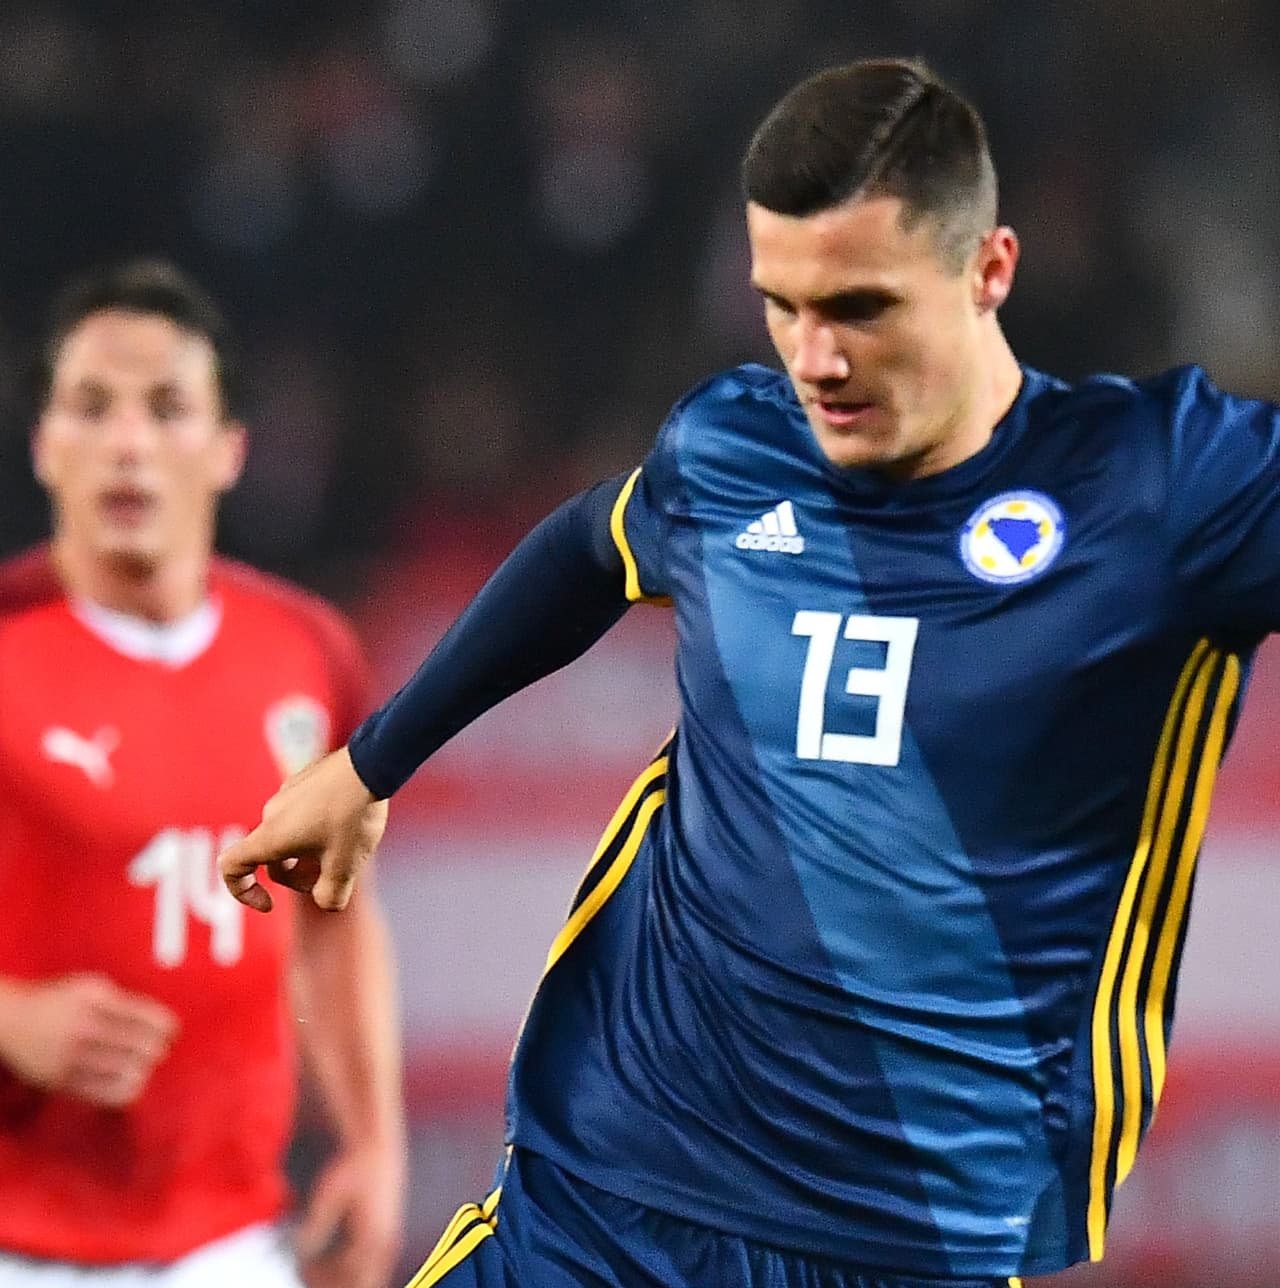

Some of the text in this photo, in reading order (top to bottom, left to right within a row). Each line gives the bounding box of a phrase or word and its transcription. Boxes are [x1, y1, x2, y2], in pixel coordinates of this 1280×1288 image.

[735, 532, 806, 555] adidas
[791, 610, 920, 767] 13
[128, 824, 246, 969] 14
